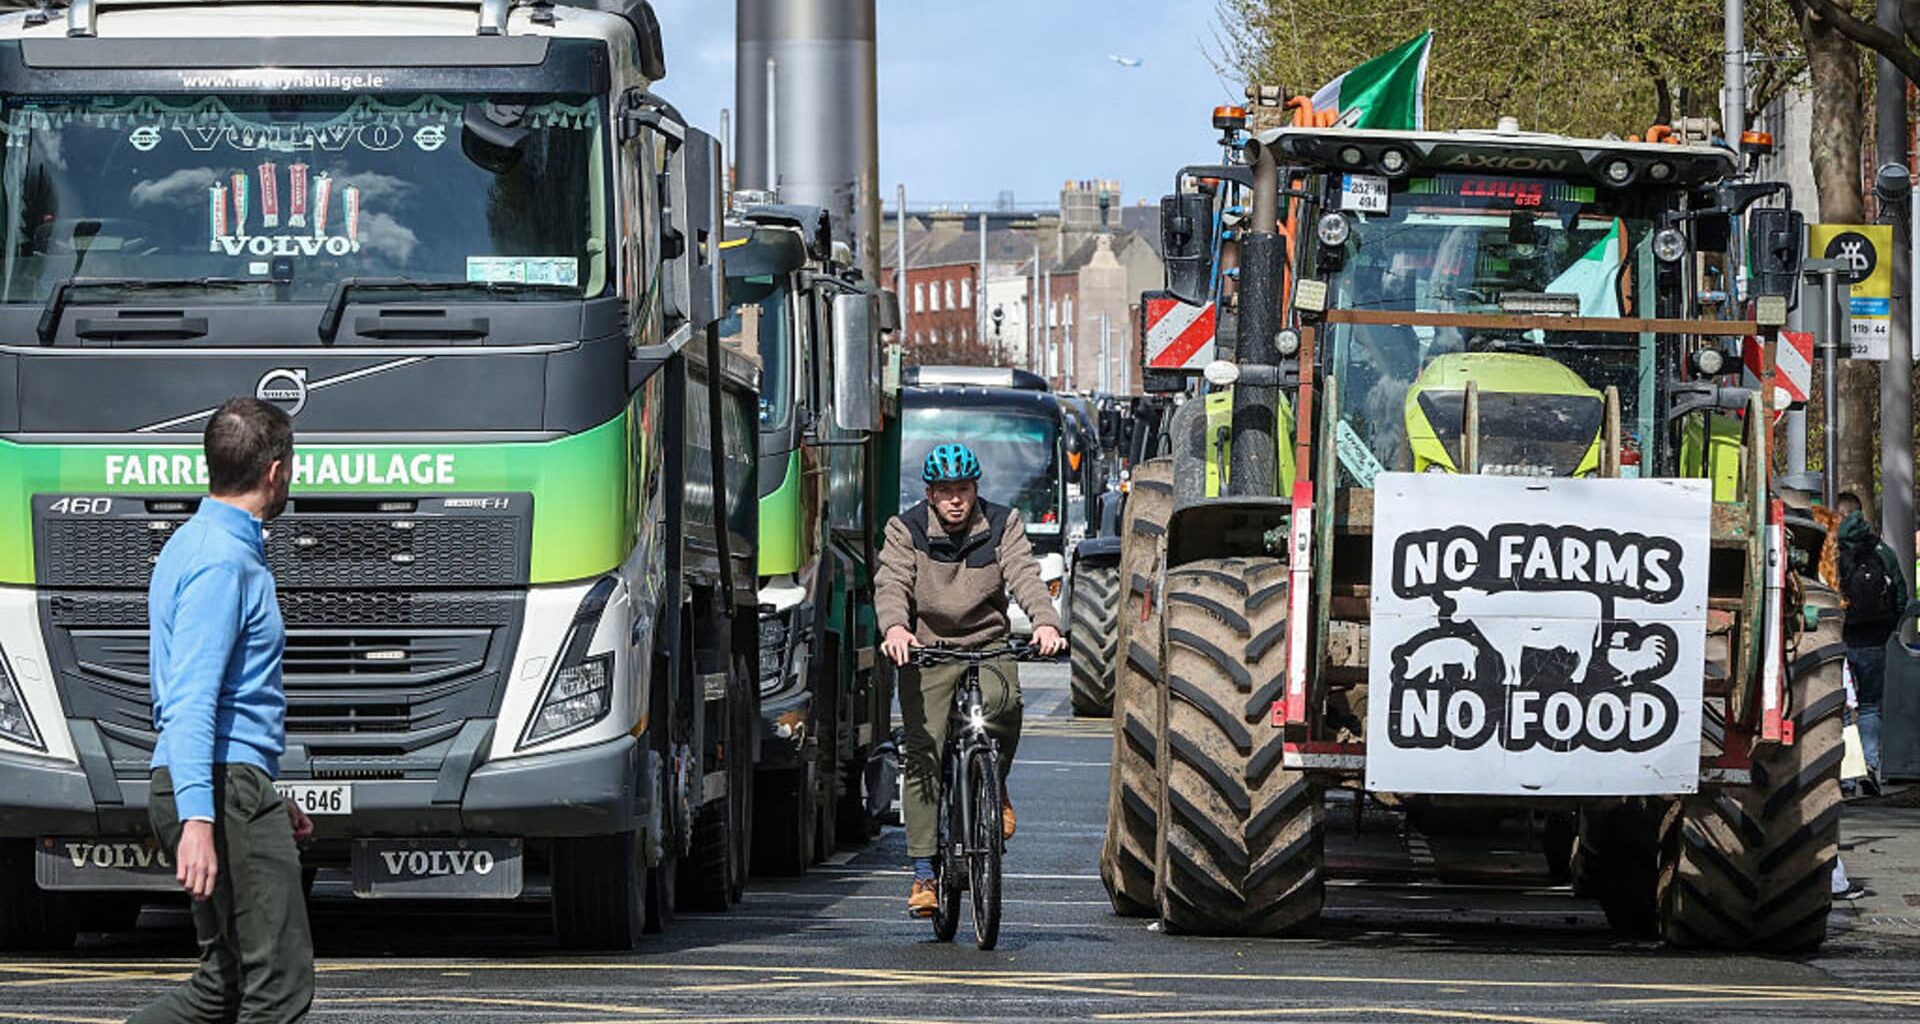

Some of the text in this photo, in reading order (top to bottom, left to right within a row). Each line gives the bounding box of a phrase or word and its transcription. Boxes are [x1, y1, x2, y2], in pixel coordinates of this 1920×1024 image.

[172, 122, 404, 150] VOLVO
[1446, 153, 1568, 171] AXION
[217, 236, 350, 256] VOLVO
[105, 455, 455, 485] FARRE HAULAGE
[49, 497, 112, 514] 460
[1404, 536, 1672, 593] NO FARMS
[1400, 689, 1667, 742] NO FOOD
[380, 850, 494, 875] VOLVO
